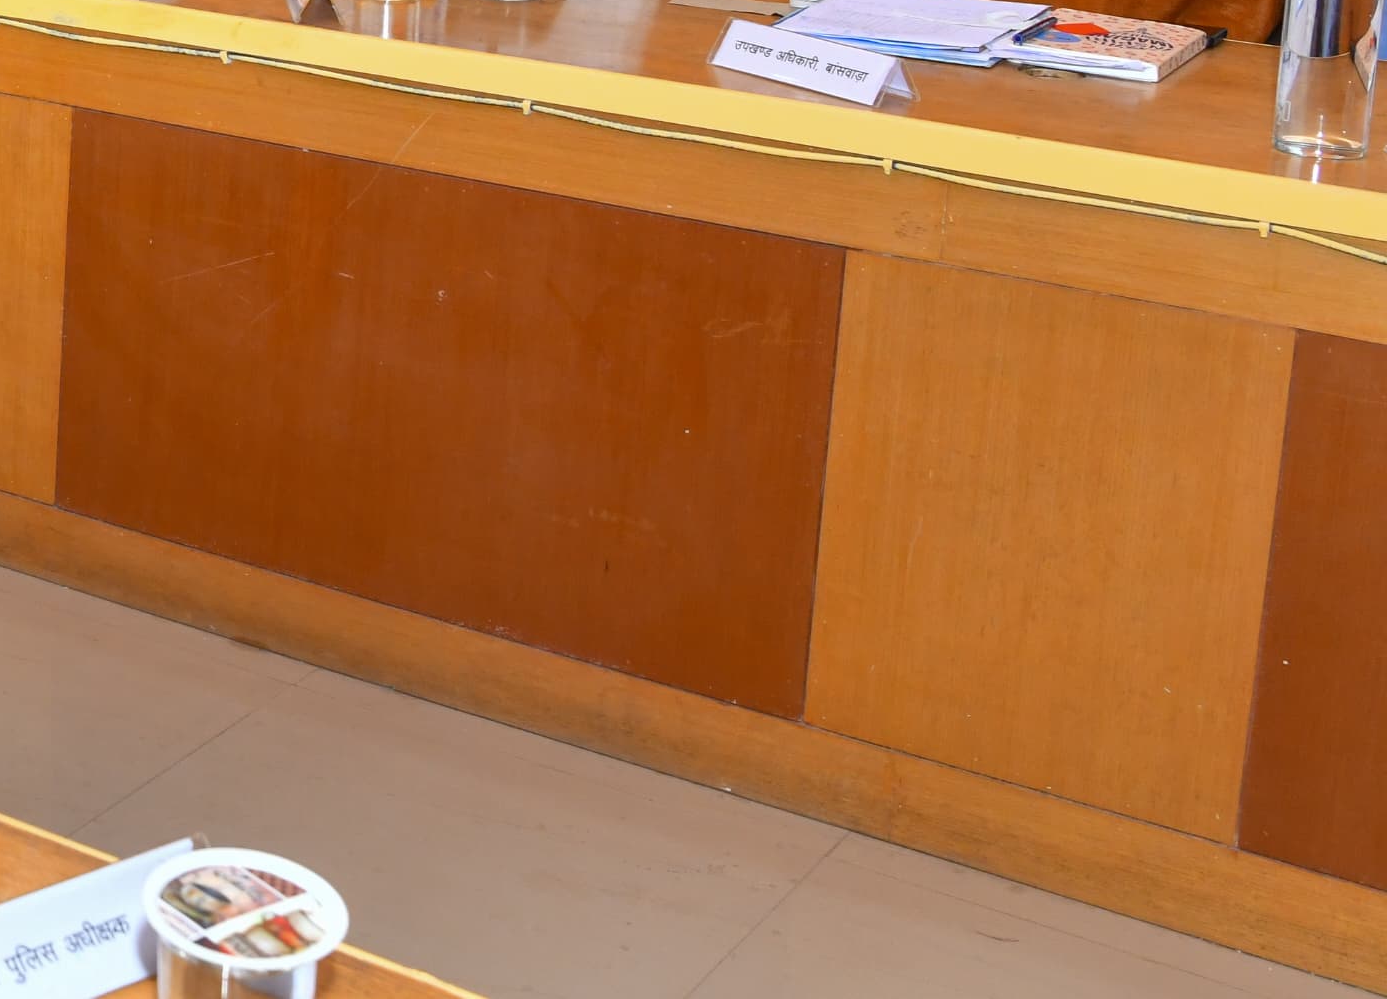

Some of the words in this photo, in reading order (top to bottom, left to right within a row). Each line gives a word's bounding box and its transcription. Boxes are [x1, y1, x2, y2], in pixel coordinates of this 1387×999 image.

[734, 39, 774, 58] उपखण्ड
[776, 49, 820, 72] अधिकारी,
[4, 941, 59, 985] पुलिस
[63, 913, 131, 954] अधीक्षक
